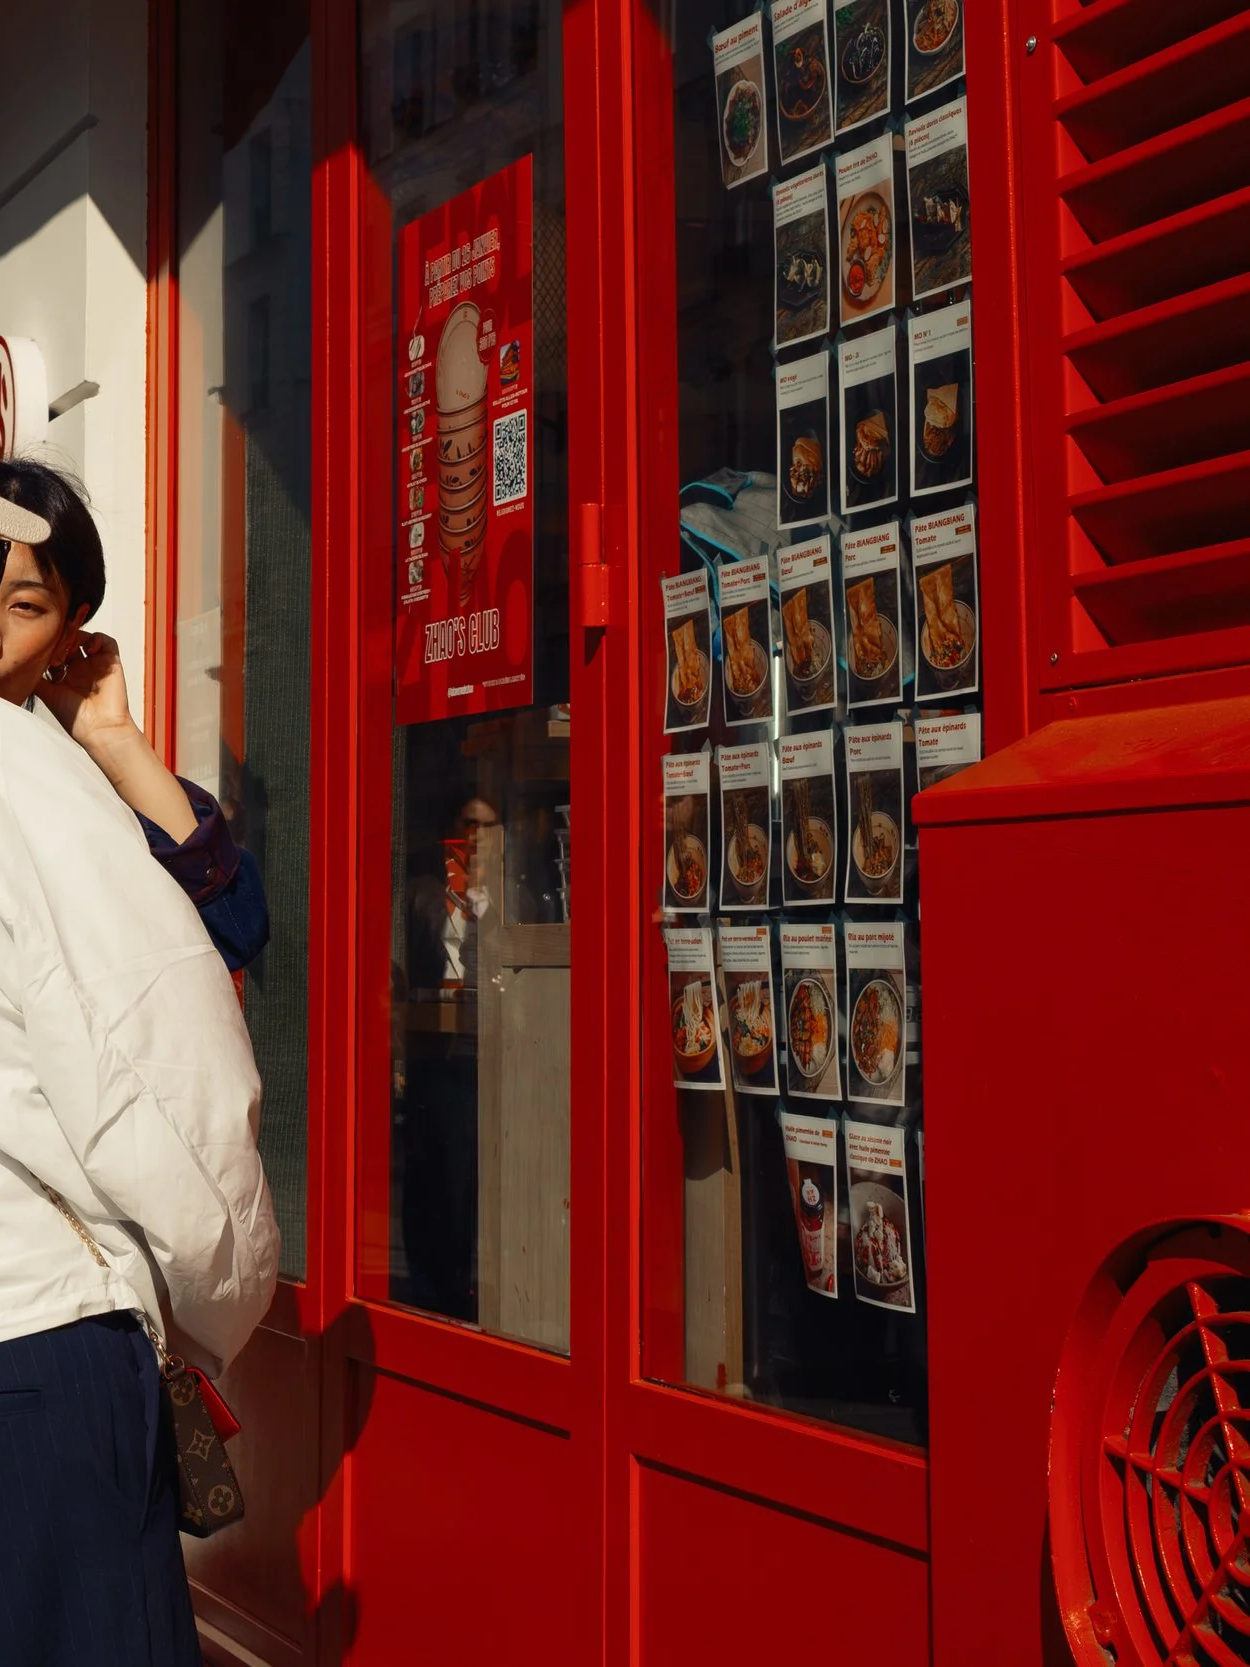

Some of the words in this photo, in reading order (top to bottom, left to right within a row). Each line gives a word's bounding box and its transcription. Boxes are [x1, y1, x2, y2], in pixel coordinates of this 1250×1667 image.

[738, 25, 759, 45] piment
[915, 524, 927, 534] Pâte
[928, 513, 965, 530] BIANGBIANG
[857, 533, 890, 548] BIANGBIANG
[915, 535, 937, 546] Tomate
[791, 547, 822, 562] BIANGBIANG
[845, 555, 856, 563] Porc
[731, 563, 761, 576] BIANGBIANG
[425, 616, 466, 664] ZHAO'S
[469, 608, 500, 654] CLUB
[918, 727, 930, 735] Pâte
[942, 722, 967, 734] épinards
[848, 735, 860, 744] Pâte
[861, 735, 871, 743] aux
[871, 733, 892, 744] épinards
[918, 739, 938, 747] Tomate
[802, 740, 822, 752] épinards
[850, 748, 862, 756] Porc
[798, 935, 814, 943] poulet
[848, 933, 857, 941] Riz
[866, 935, 877, 943] porc
[878, 933, 894, 943] mijoté
[786, 1135, 798, 1143] ZHAO
[874, 1157, 888, 1165] ZHAO
